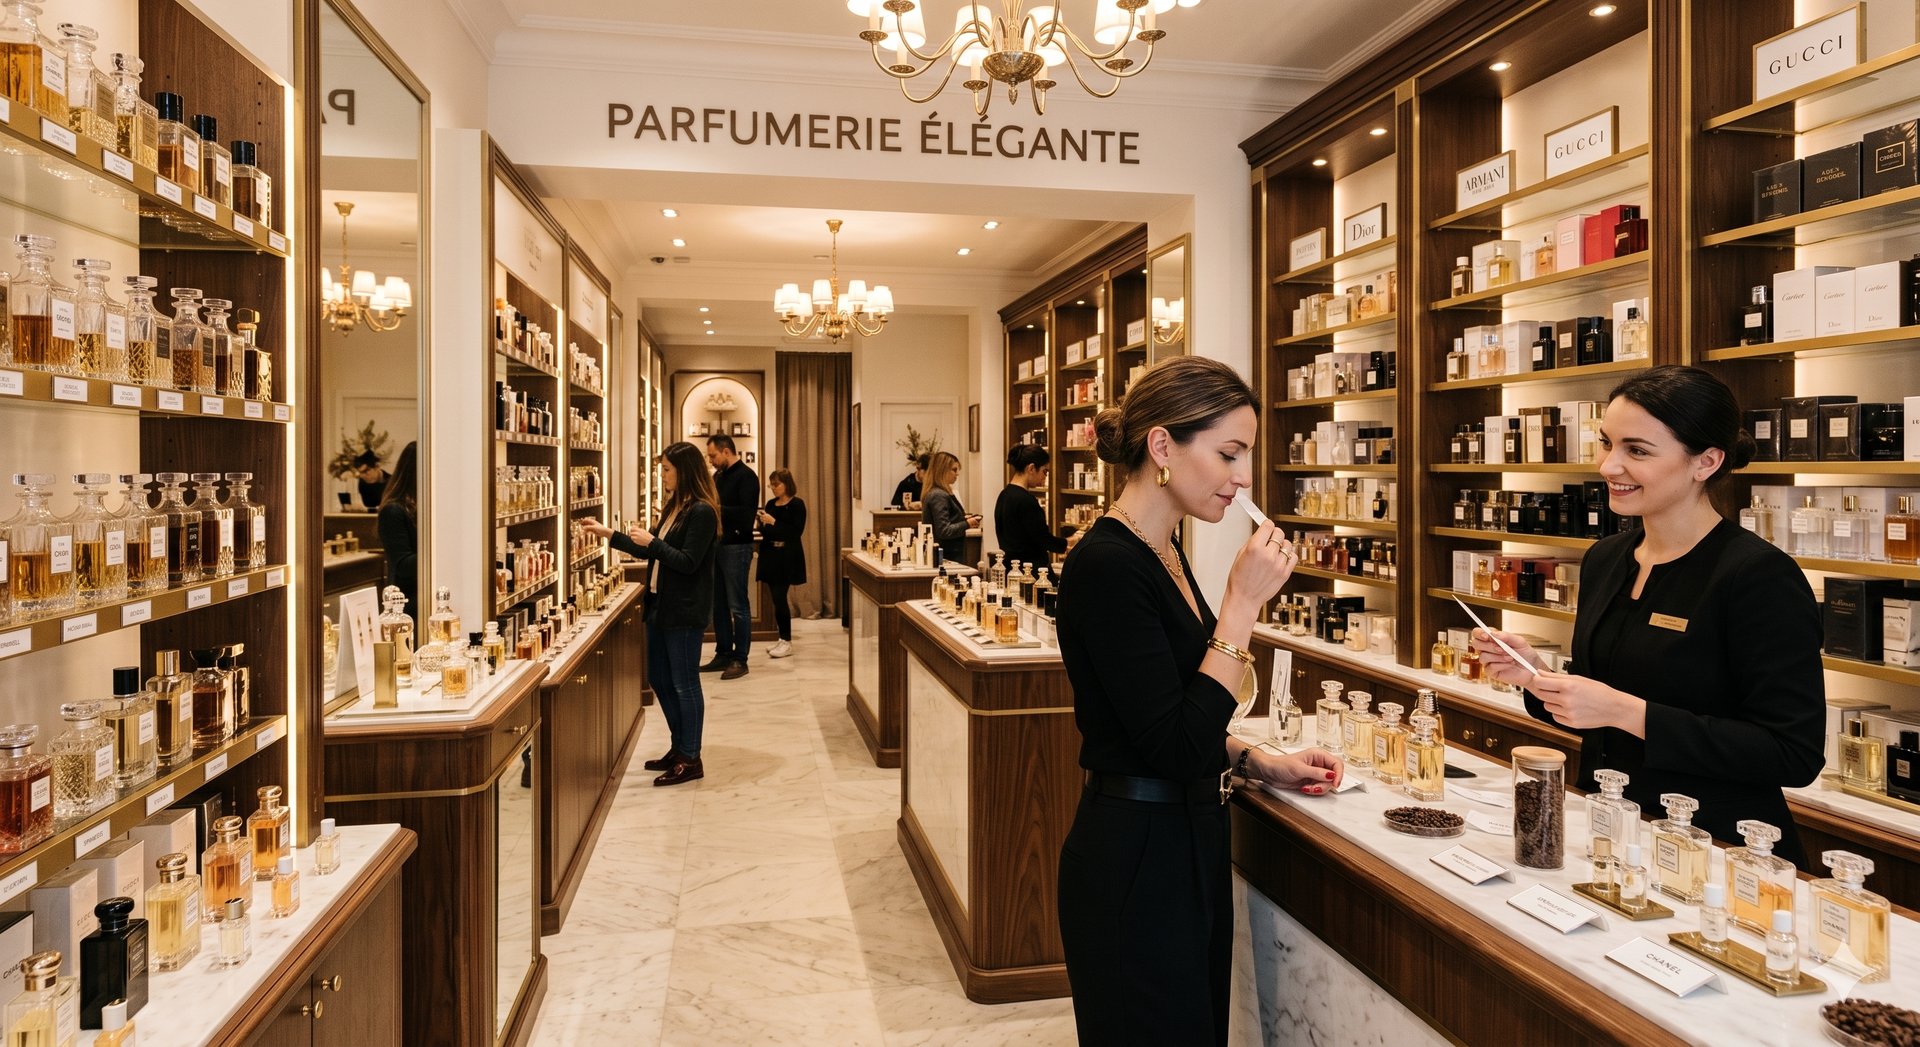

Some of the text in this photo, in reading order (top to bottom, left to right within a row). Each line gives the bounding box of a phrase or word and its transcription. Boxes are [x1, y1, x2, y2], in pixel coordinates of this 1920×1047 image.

[1769, 35, 1843, 75] GUCCI
[608, 103, 1140, 164] PARFUMERIE ÉLÉGANTE
[1555, 130, 1604, 159] GUCCI
[1464, 165, 1505, 193] ARMANI
[1352, 223, 1376, 241] Dior
[1781, 292, 1806, 302] Cartier
[1823, 291, 1846, 301] Cartier
[1864, 283, 1889, 293] Cartier
[1646, 953, 1683, 975] CHANEL
